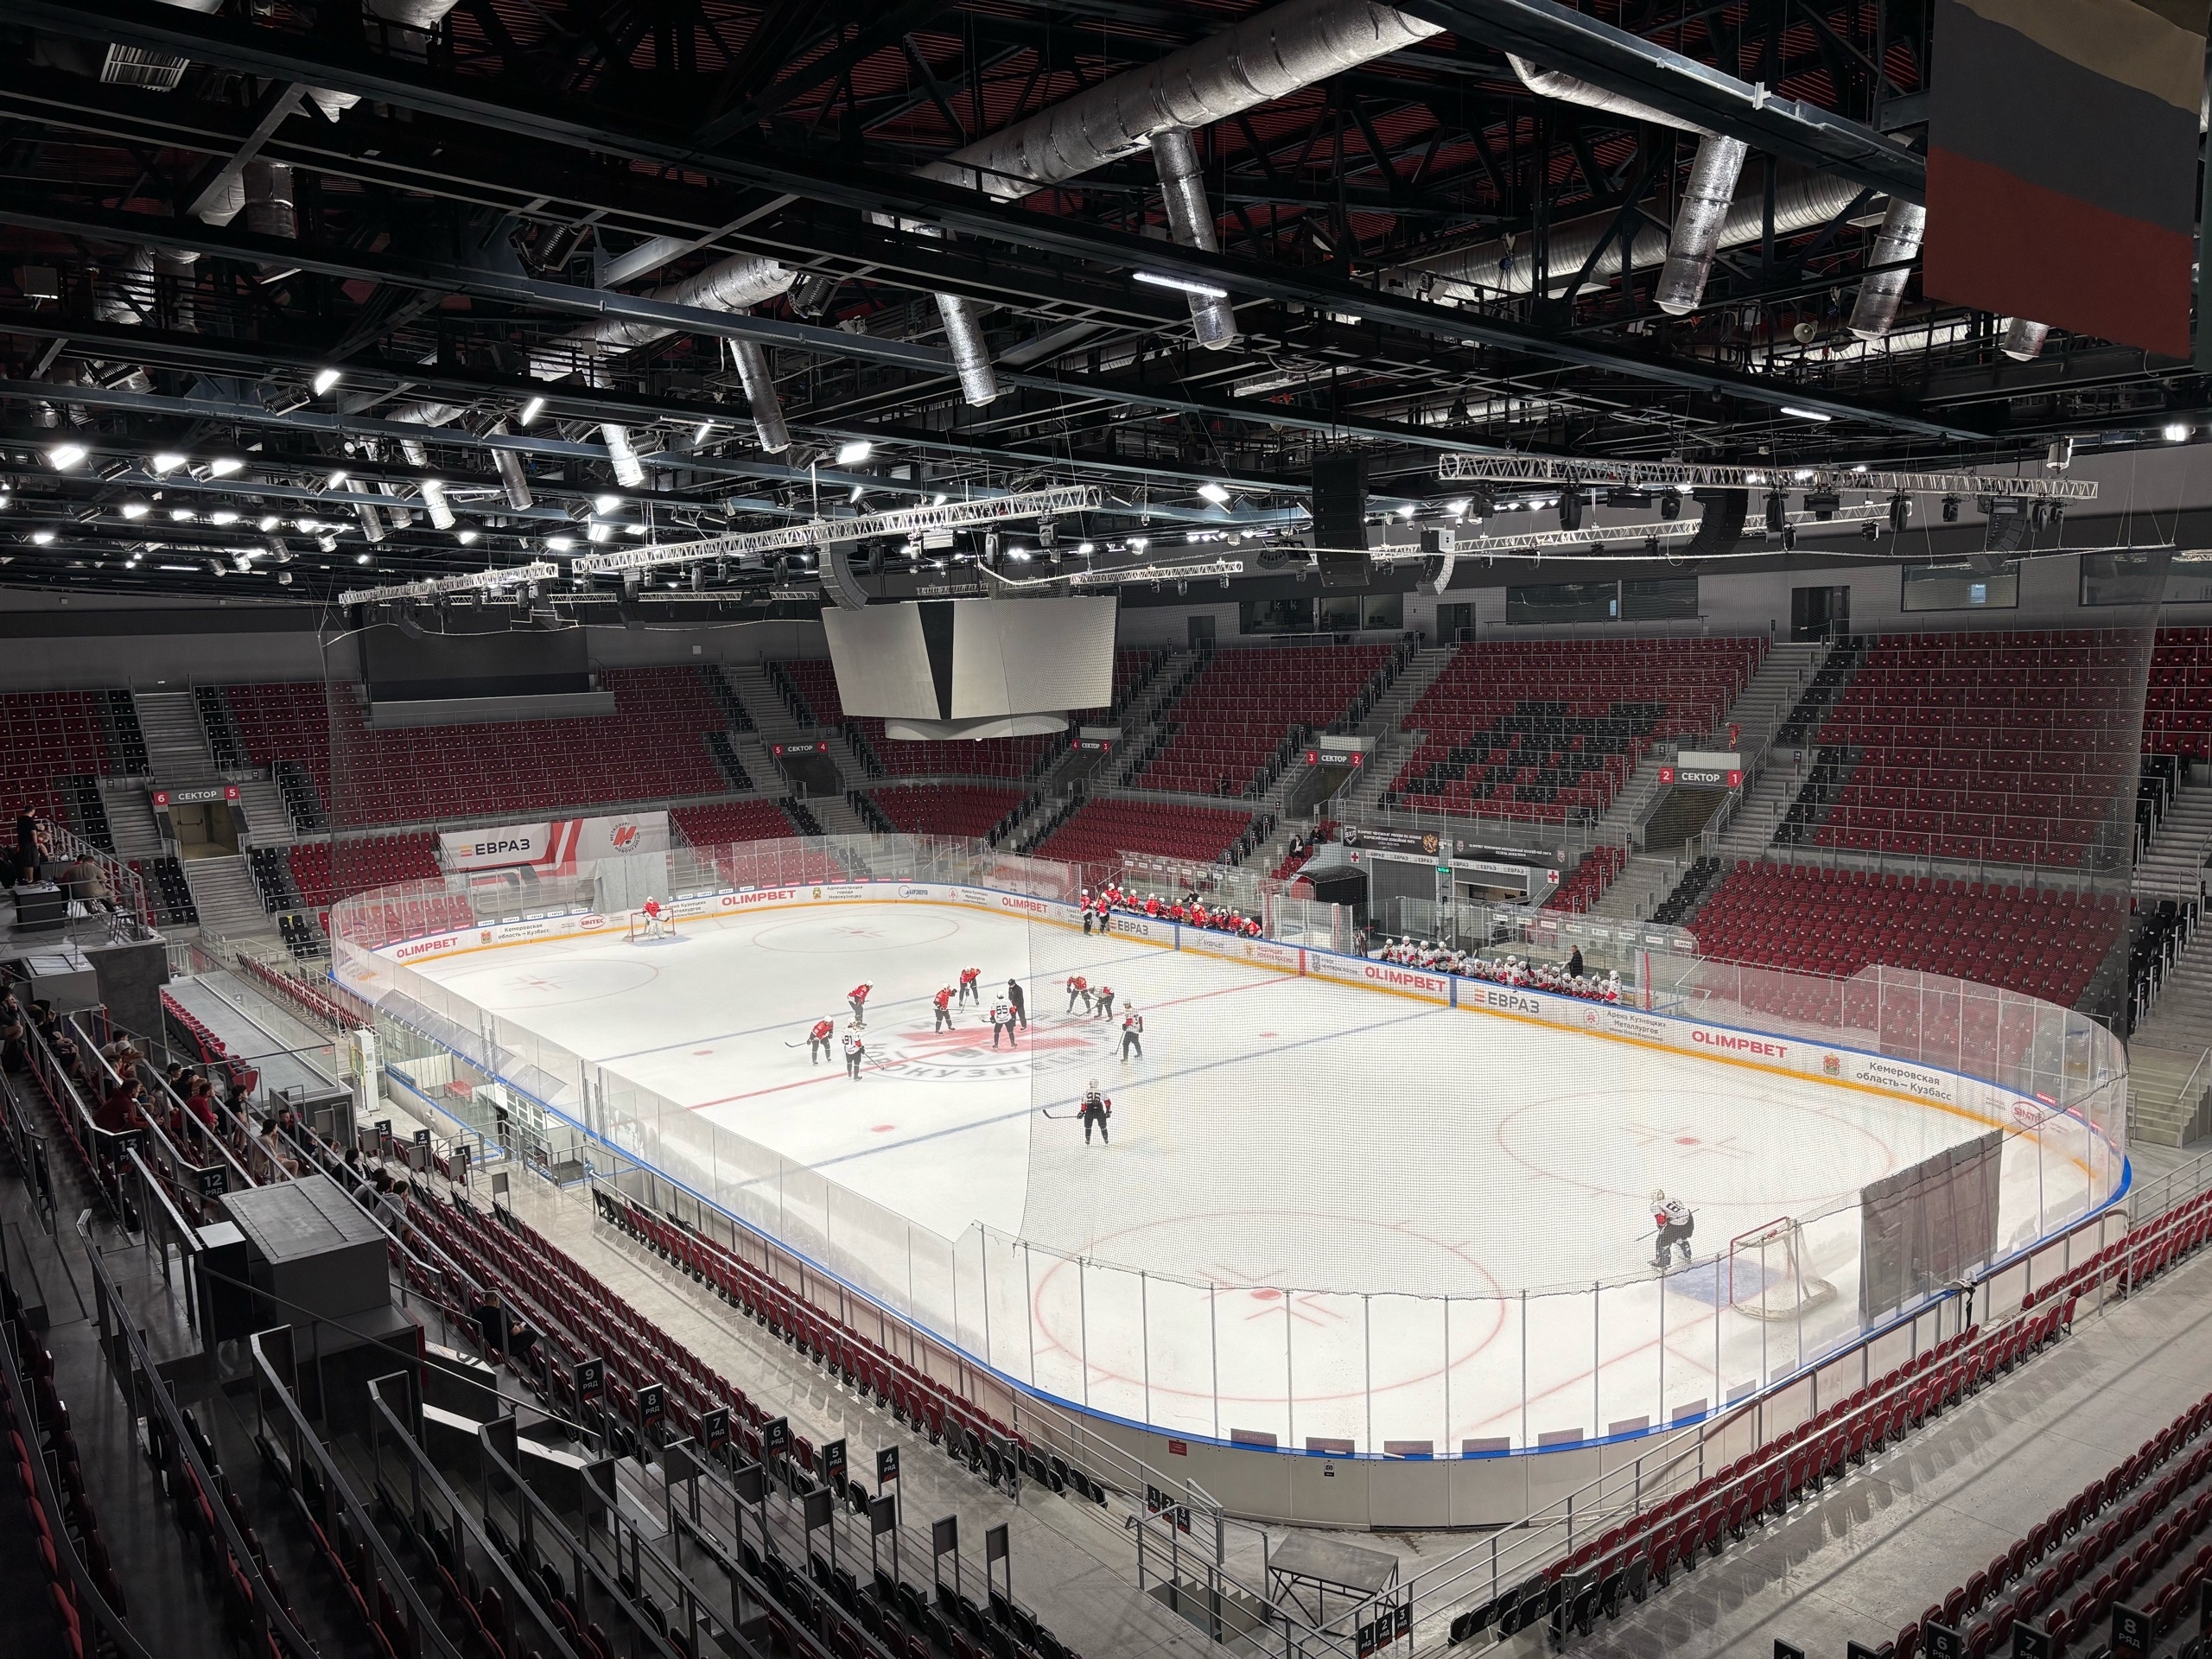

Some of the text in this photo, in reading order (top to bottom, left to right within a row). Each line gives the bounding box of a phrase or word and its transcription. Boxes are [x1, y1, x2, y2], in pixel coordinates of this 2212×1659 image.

[1663, 771, 1738, 784] 2 СЕКТОР 1
[178, 791, 217, 800] СЕКТОР
[610, 823, 631, 842] МЕТАЛЛУРГ
[475, 838, 531, 855] ЕВРАЗ
[721, 890, 796, 906] OLIMPBET
[1002, 897, 1048, 913] OLIMPBET
[505, 924, 543, 932] Кемеровская
[1118, 920, 1148, 936] ЕВРАЗ
[397, 938, 458, 958] OLIMPBET
[1365, 966, 1446, 993] OLIMPBET
[1488, 990, 1541, 1015] ЕВРАЗ
[996, 1005, 1008, 1015] 55
[1607, 1011, 1666, 1028] Арена Кузнецких
[1615, 1020, 1659, 1034] Металлургов
[845, 1035, 853, 1045] 91
[1692, 1031, 1788, 1058] OLIMPBET
[1870, 1062, 1940, 1086] Кемеровская
[1857, 1072, 1899, 1087] область
[1910, 1083, 1952, 1101] Кузбасс
[118, 1139, 137, 1153] 13
[204, 1174, 223, 1188] 12
[585, 1369, 594, 1381] 9
[583, 1381, 599, 1390] РЯД
[648, 1394, 657, 1406] 8
[645, 1406, 660, 1415] РЯД
[713, 1417, 721, 1429] 7
[711, 1429, 725, 1438] РЯД
[773, 1427, 781, 1438] 6
[772, 1438, 785, 1446] РЯД
[832, 1446, 839, 1459] 5
[886, 1453, 893, 1464] 4
[884, 1464, 896, 1473] РЯД
[1153, 1491, 1156, 1500] 1
[1166, 1499, 1171, 1508] 2
[1400, 1609, 1406, 1620] 3
[1382, 1619, 1388, 1630] 2
[2124, 1618, 2137, 1635] 8
[1364, 1630, 1369, 1640] 1
[2119, 1632, 2140, 1649] РЯД
[1937, 1637, 1948, 1650] 6
[2025, 1636, 2037, 1650] 7
